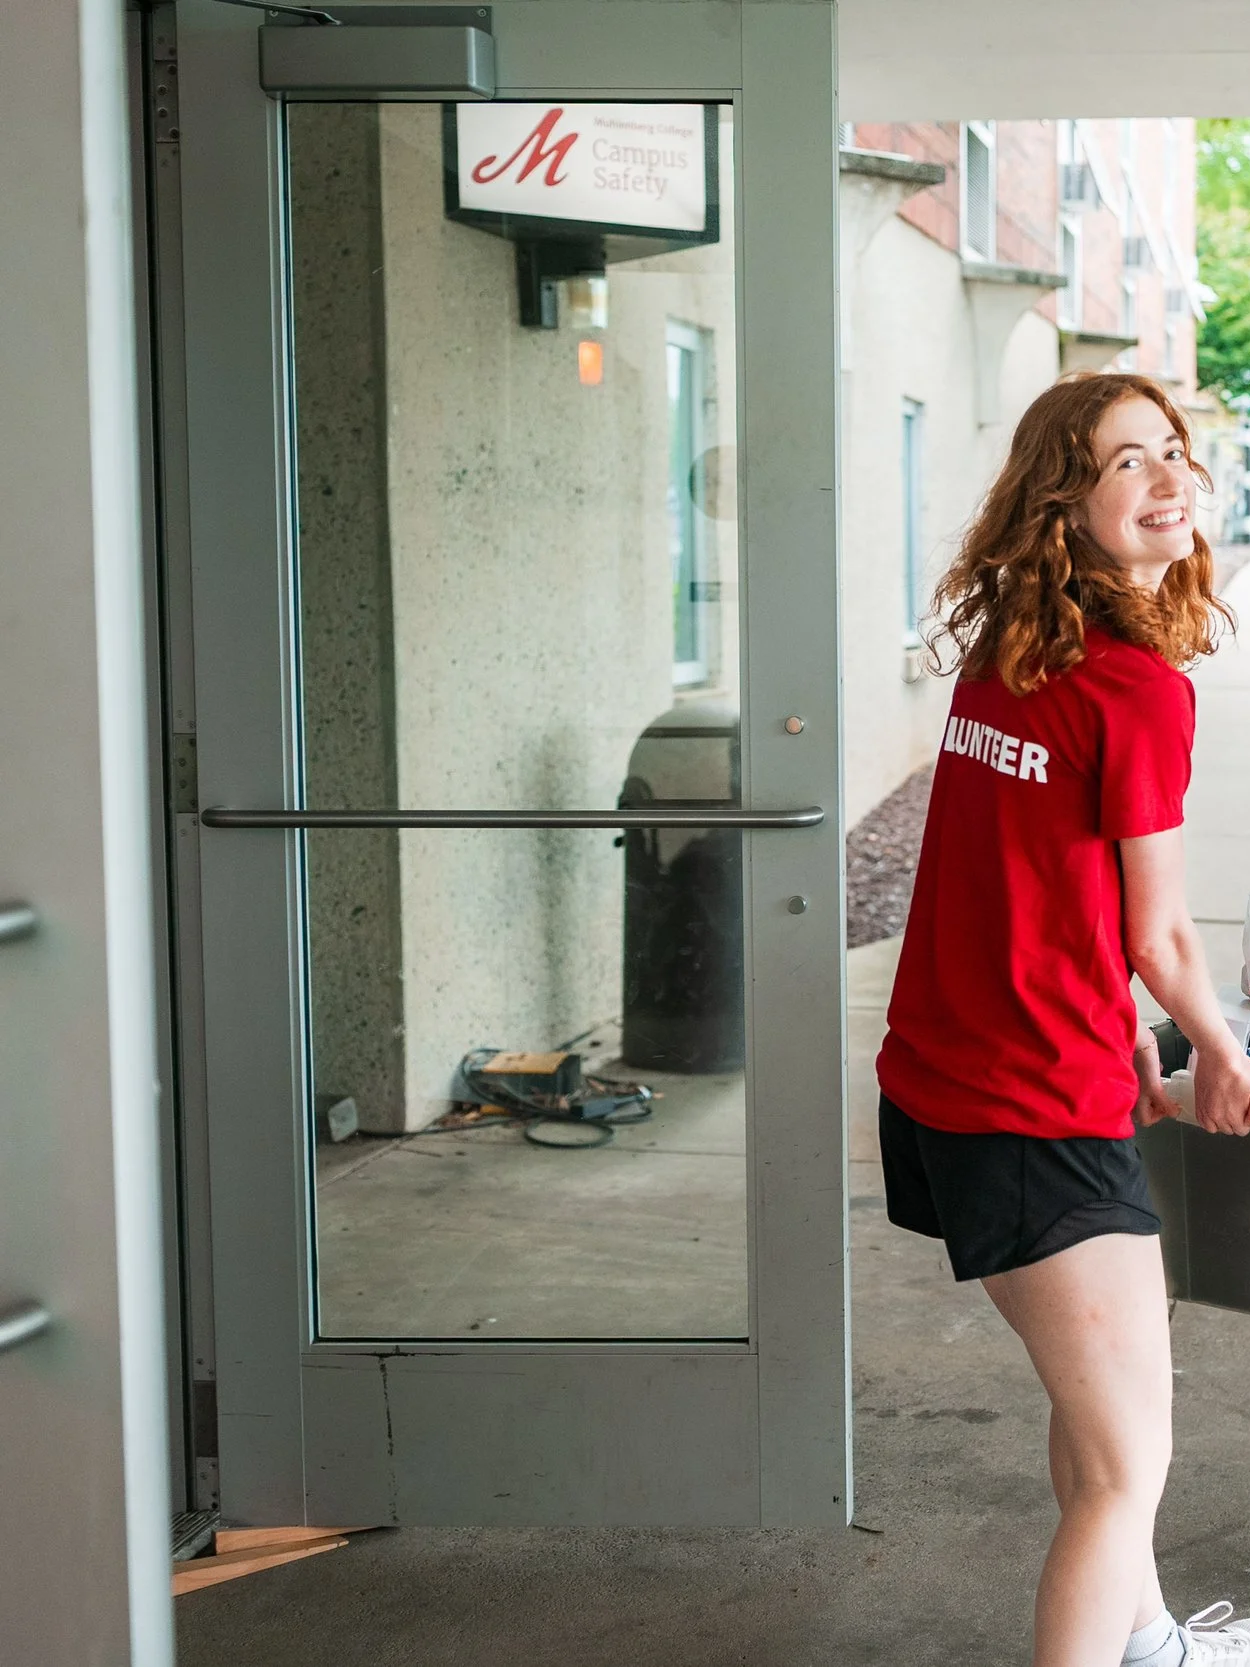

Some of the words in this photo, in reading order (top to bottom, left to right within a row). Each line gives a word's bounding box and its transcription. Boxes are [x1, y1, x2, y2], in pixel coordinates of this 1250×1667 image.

[656, 123, 693, 138] College
[592, 138, 688, 173] Campus
[593, 166, 668, 201] Safety
